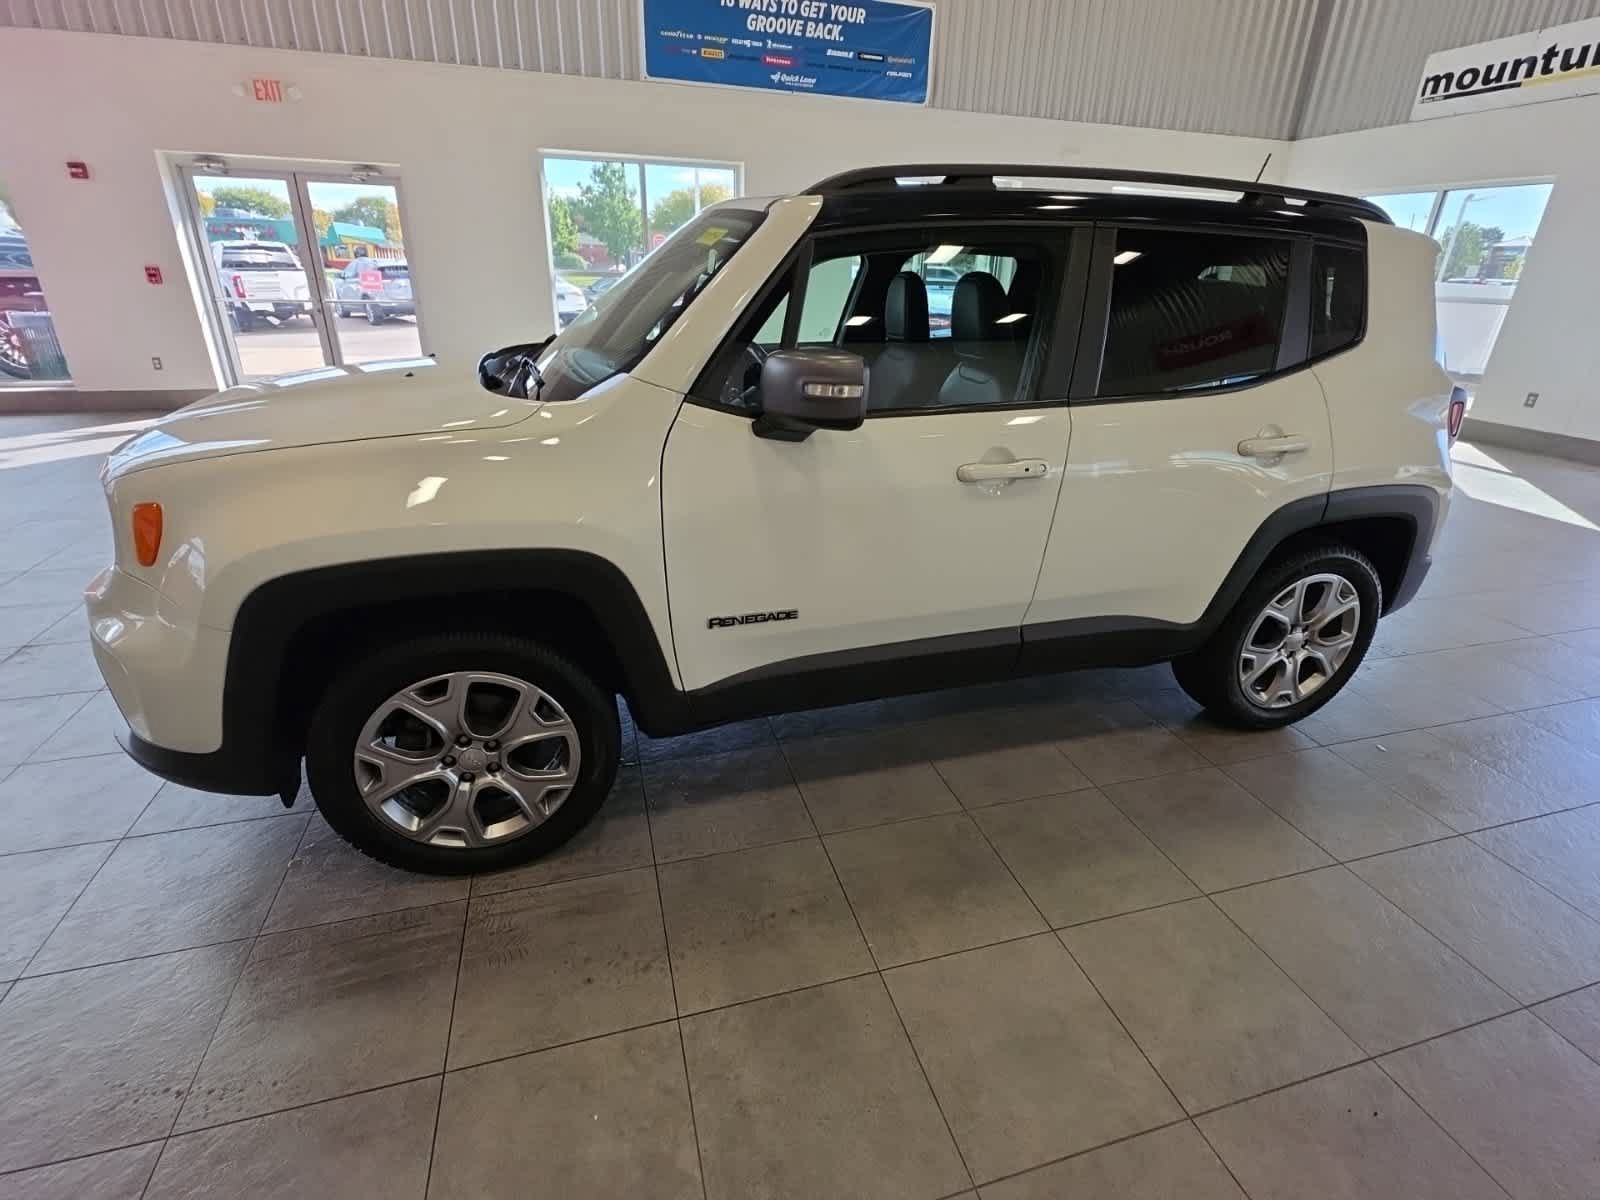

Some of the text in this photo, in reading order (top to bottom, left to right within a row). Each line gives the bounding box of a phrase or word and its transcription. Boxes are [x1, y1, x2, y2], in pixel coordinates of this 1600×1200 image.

[781, 0, 798, 15] TO
[800, 1, 827, 19] GET
[830, 4, 866, 24] YOUR
[746, 14, 844, 41] GROOVE BACK.
[253, 78, 282, 103] EXIT
[707, 609, 799, 629] RENEGADE
